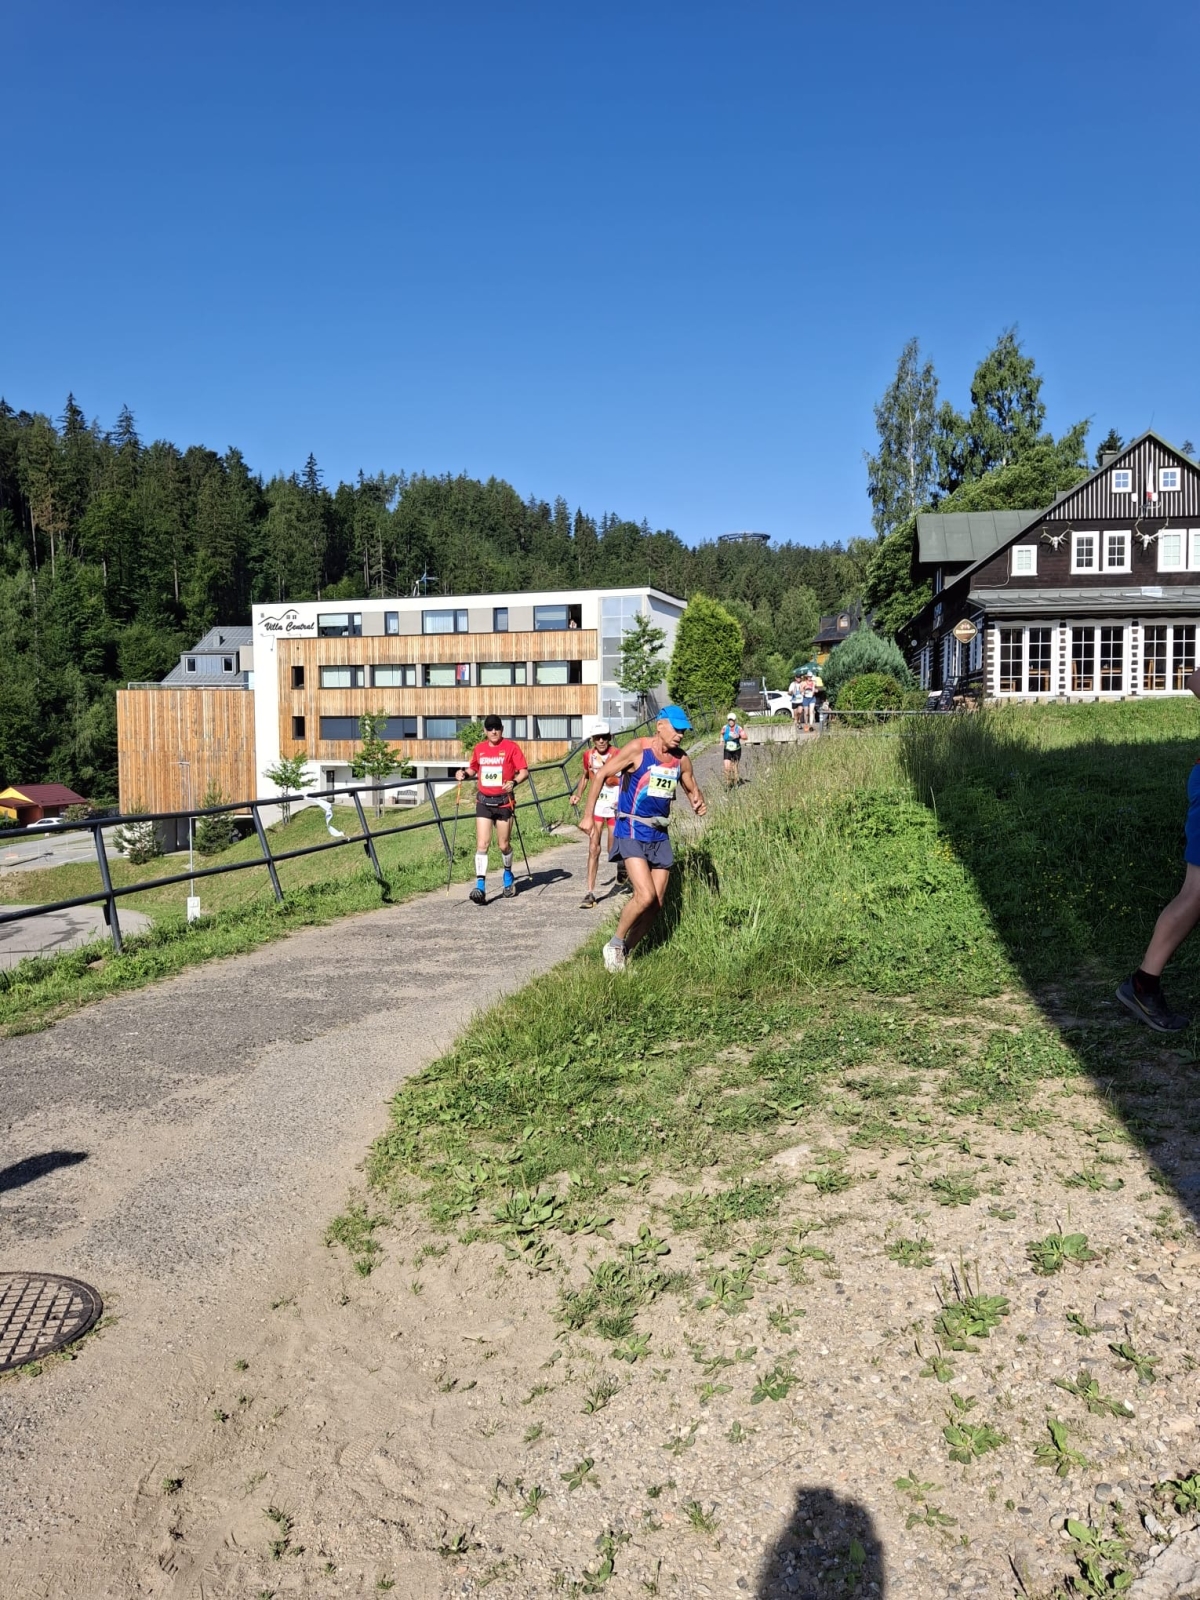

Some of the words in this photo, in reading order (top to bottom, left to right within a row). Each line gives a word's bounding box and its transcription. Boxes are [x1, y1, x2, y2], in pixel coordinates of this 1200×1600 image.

[264, 621, 283, 631] Villa
[285, 621, 315, 632] Central
[656, 777, 672, 789] 721
